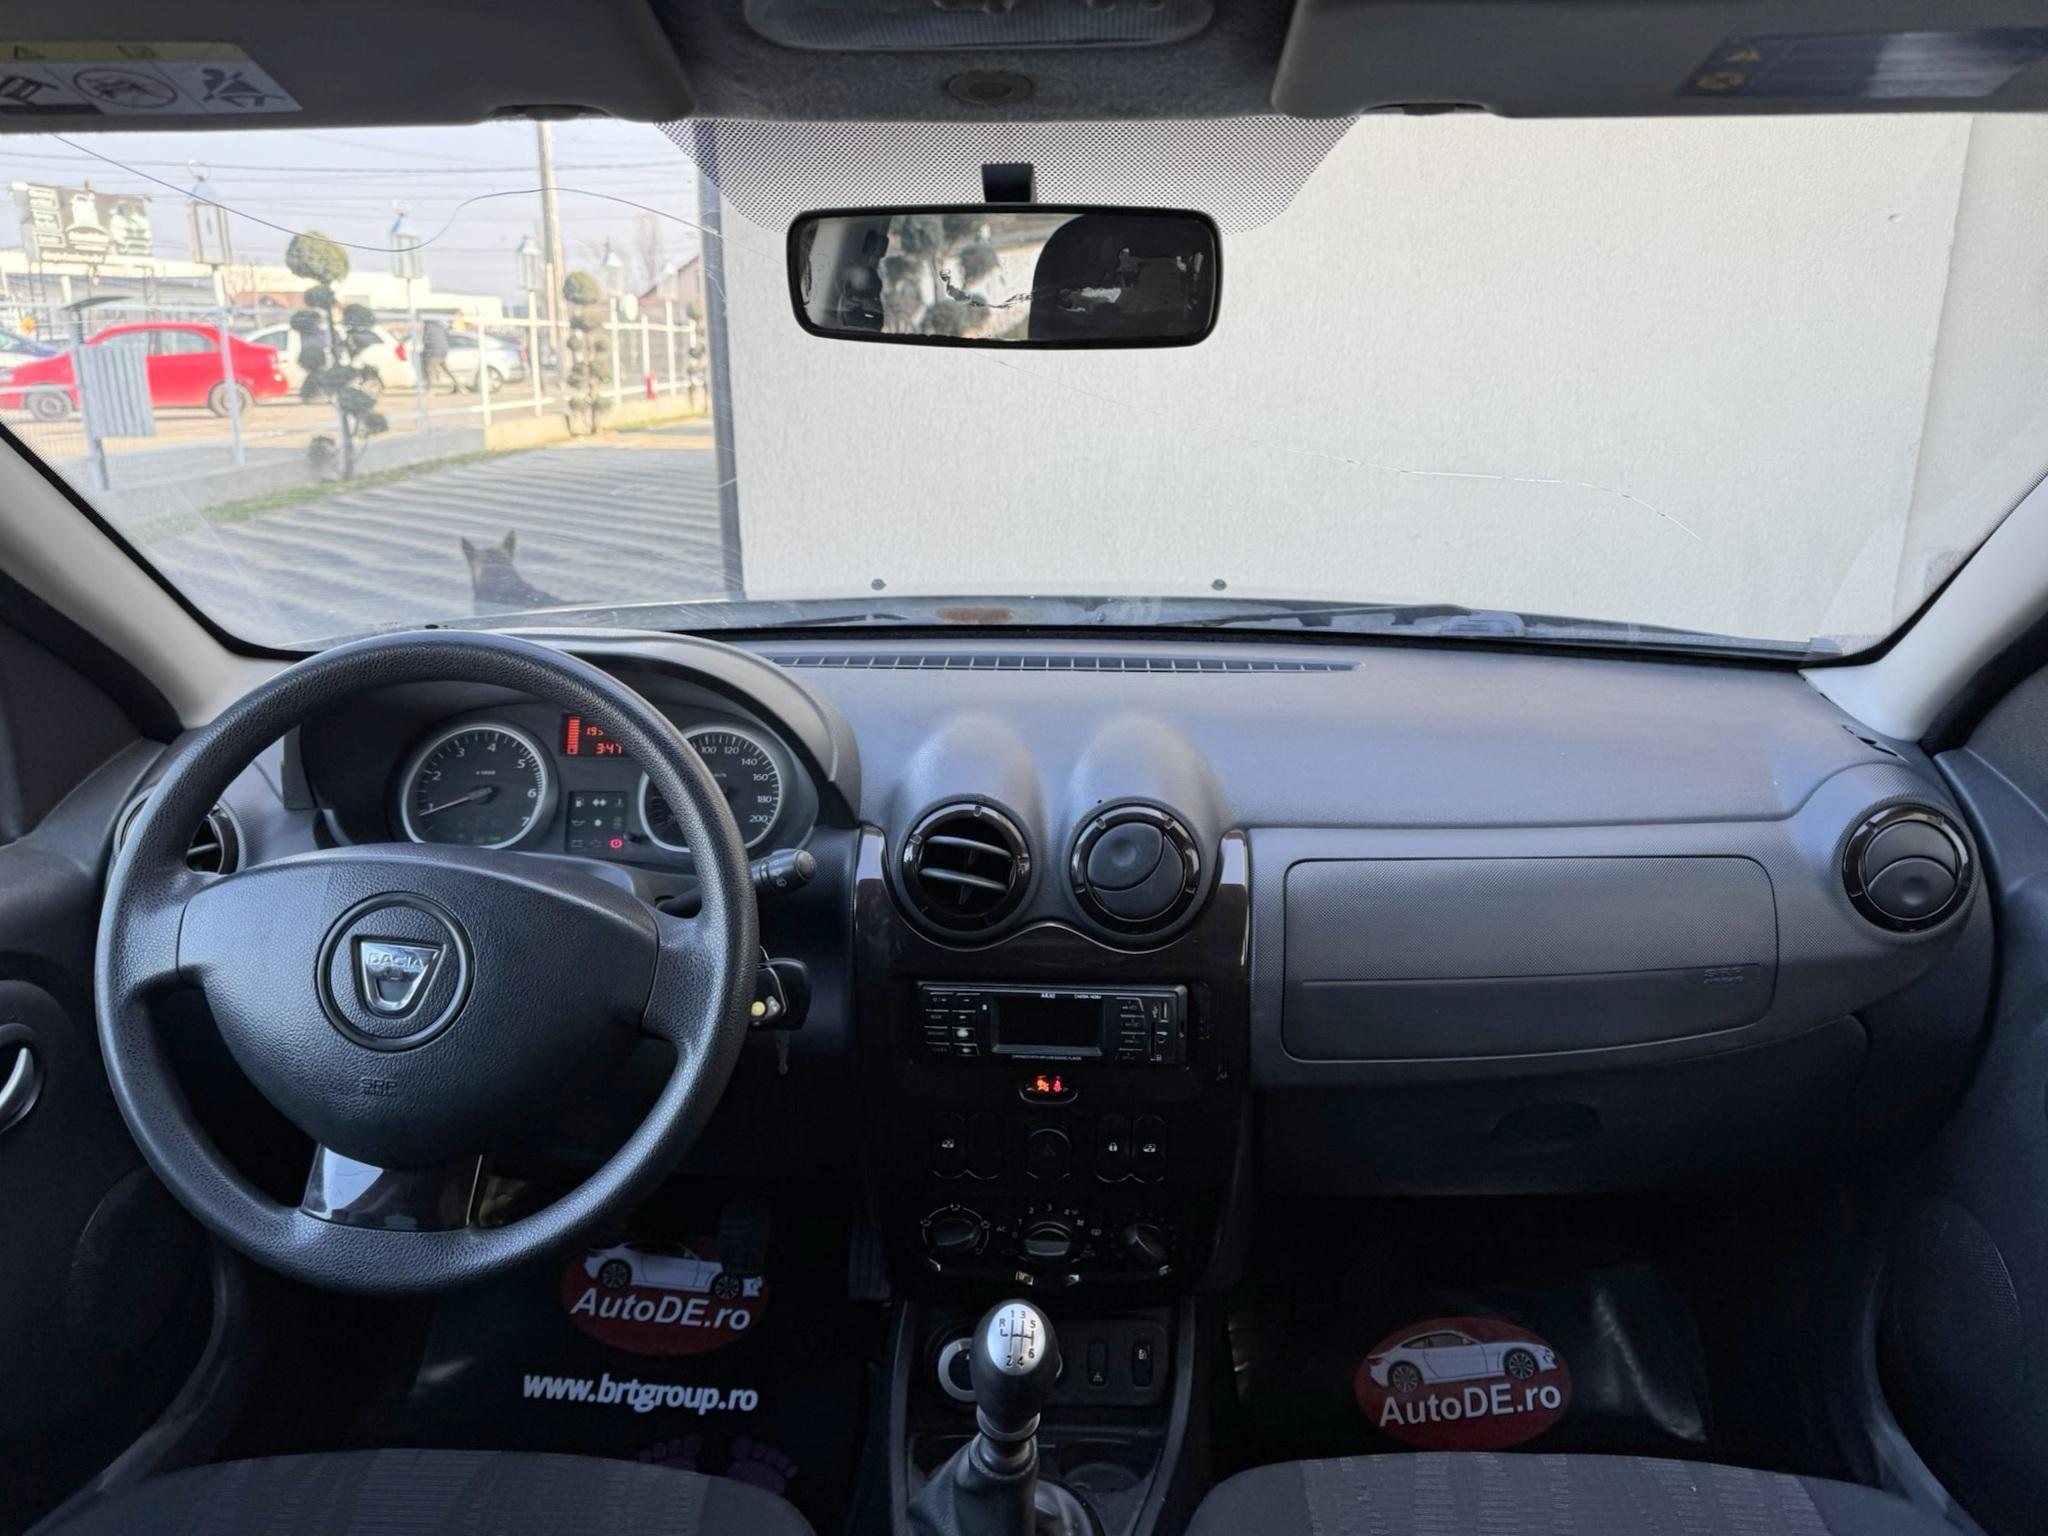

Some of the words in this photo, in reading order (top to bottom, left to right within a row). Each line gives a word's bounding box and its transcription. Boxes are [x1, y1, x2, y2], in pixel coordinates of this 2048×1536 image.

[455, 747, 466, 758] 3
[486, 743, 497, 753] 4
[701, 745, 717, 755] 100
[723, 745, 740, 755] 120
[515, 758, 526, 769] 5
[741, 757, 758, 766] 140
[431, 770, 442, 781] 2
[752, 773, 769, 782] 160
[526, 788, 537, 798] 6
[520, 816, 531, 828] 7
[748, 814, 768, 824] 200
[366, 952, 426, 969] DACIA
[569, 1287, 751, 1331] AutoDE.ro
[1020, 1310, 1026, 1319] 3
[999, 1318, 1006, 1328] R
[1029, 1320, 1036, 1329] 5
[1028, 1348, 1035, 1359] 6
[1005, 1355, 1012, 1367] 2
[1016, 1356, 1024, 1367] 4
[523, 1372, 759, 1416] www.brtgroup.ro
[1378, 1383, 1562, 1427] AutoDE.ro
